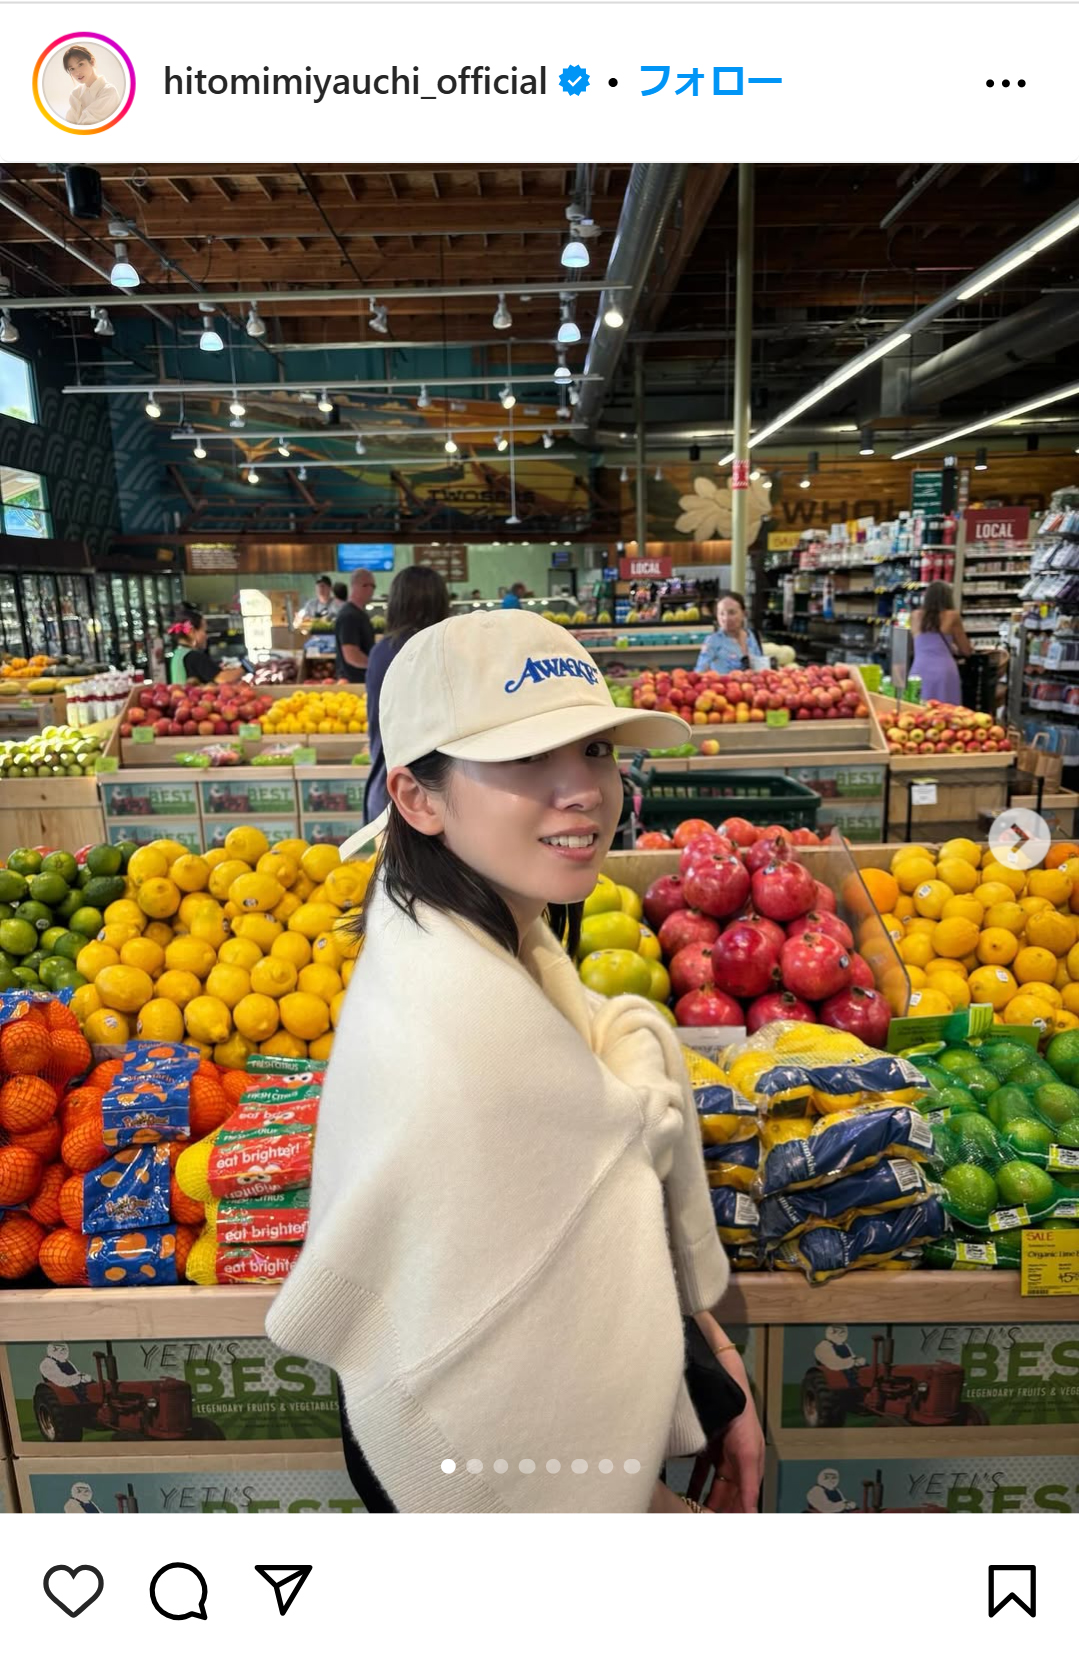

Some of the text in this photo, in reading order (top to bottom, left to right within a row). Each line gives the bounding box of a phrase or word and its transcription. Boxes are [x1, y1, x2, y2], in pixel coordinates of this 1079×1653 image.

[975, 522, 1014, 539] LOCAL
[630, 562, 661, 575] LOCAL
[836, 771, 880, 785] BEST
[149, 789, 193, 804] BEST
[247, 787, 291, 802] BEST
[834, 815, 879, 828] BEST
[238, 1111, 260, 1120] eat
[216, 1155, 239, 1170] eat
[242, 1143, 300, 1164] brighter!
[224, 1226, 247, 1242] eat
[1025, 1231, 1055, 1242] SALE
[224, 1261, 246, 1274] eat
[920, 1326, 1021, 1355] YETI'S
[140, 1342, 240, 1370] YETI'S
[966, 1388, 1014, 1399] LEGENDARY
[1017, 1386, 1046, 1397] FRUITS
[1049, 1386, 1057, 1396] &
[197, 1401, 340, 1414] LEGENDARY FRUITS & VEGETABLES
[907, 1471, 1004, 1496] YETI'S
[160, 1485, 257, 1509] YETI'S
